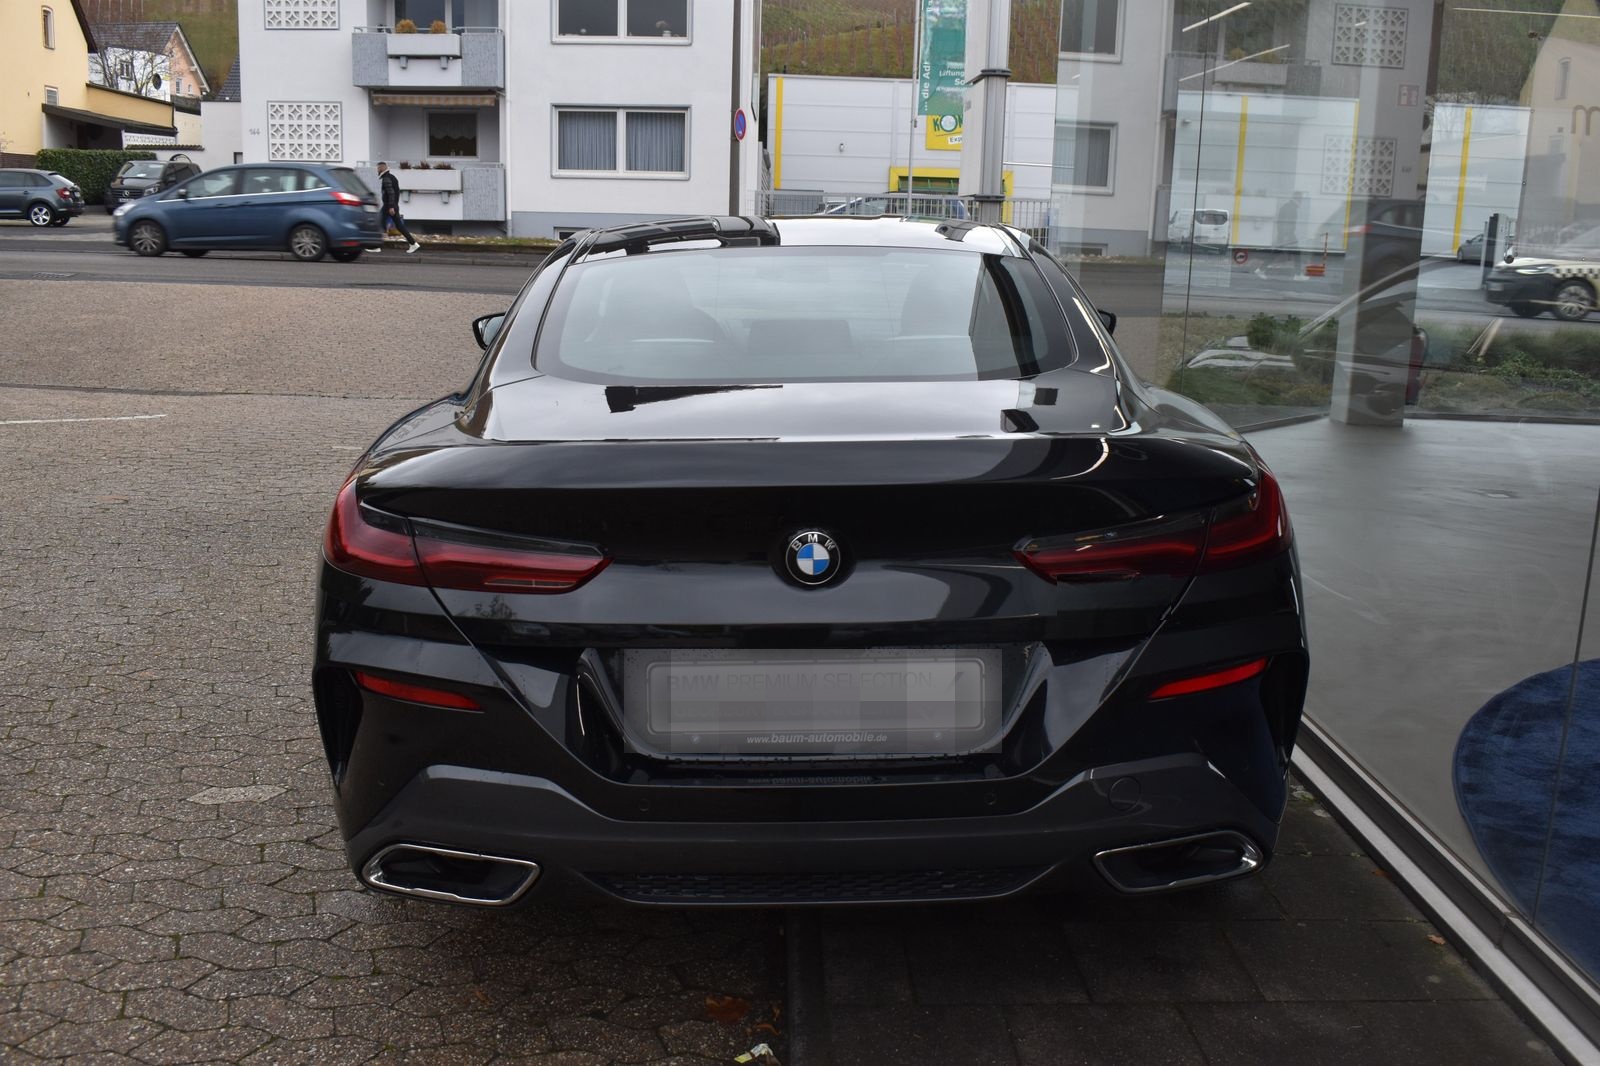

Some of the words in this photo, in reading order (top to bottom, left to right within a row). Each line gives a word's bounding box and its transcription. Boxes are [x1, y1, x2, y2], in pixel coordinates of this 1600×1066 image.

[921, 82, 929, 99] die
[791, 533, 836, 551] BMW
[667, 675, 720, 692] BMW
[727, 673, 817, 691] PREMIUM
[746, 731, 888, 744] www.baum-automobile.de
